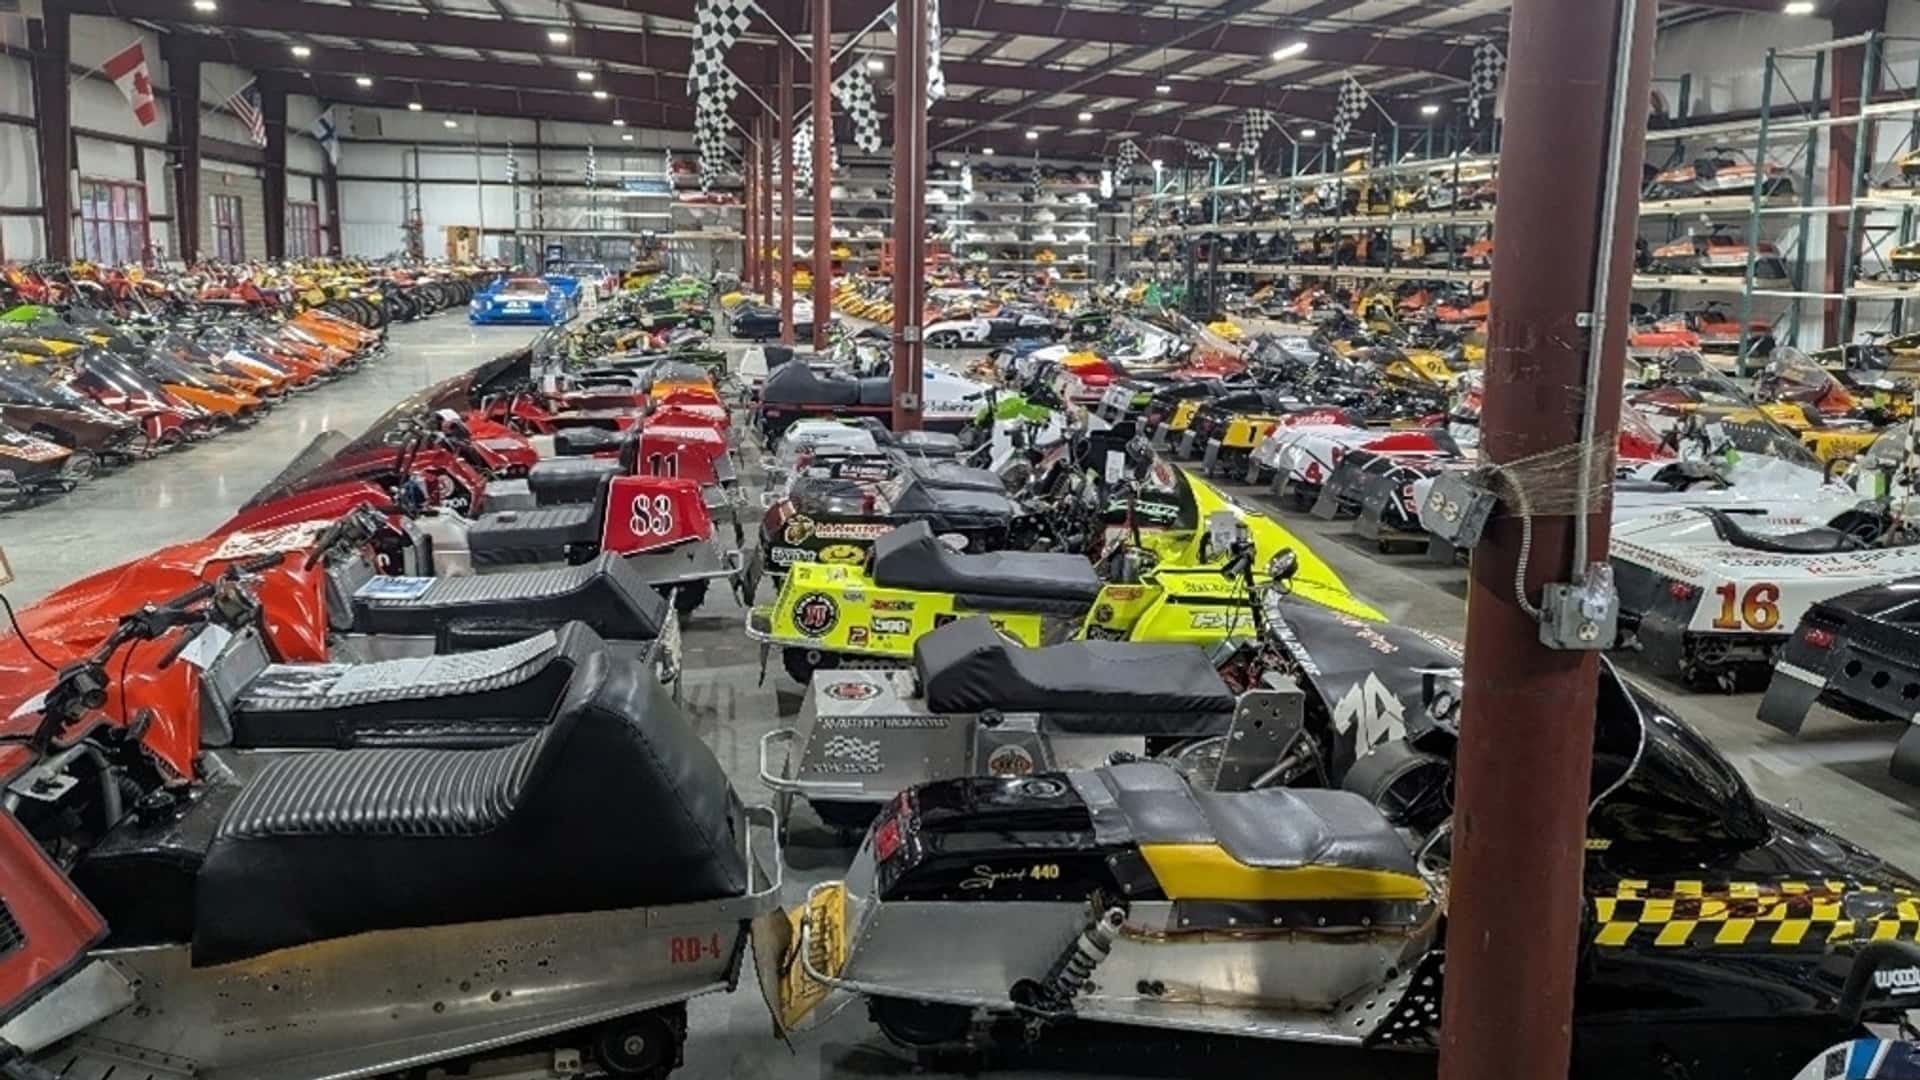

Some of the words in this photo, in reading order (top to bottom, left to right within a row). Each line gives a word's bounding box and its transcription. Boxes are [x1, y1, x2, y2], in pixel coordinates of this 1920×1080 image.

[647, 452, 679, 480] 11
[630, 494, 673, 536] 83
[1712, 582, 1780, 630] 16
[1030, 864, 1060, 880] 440
[670, 934, 722, 964] RD-4
